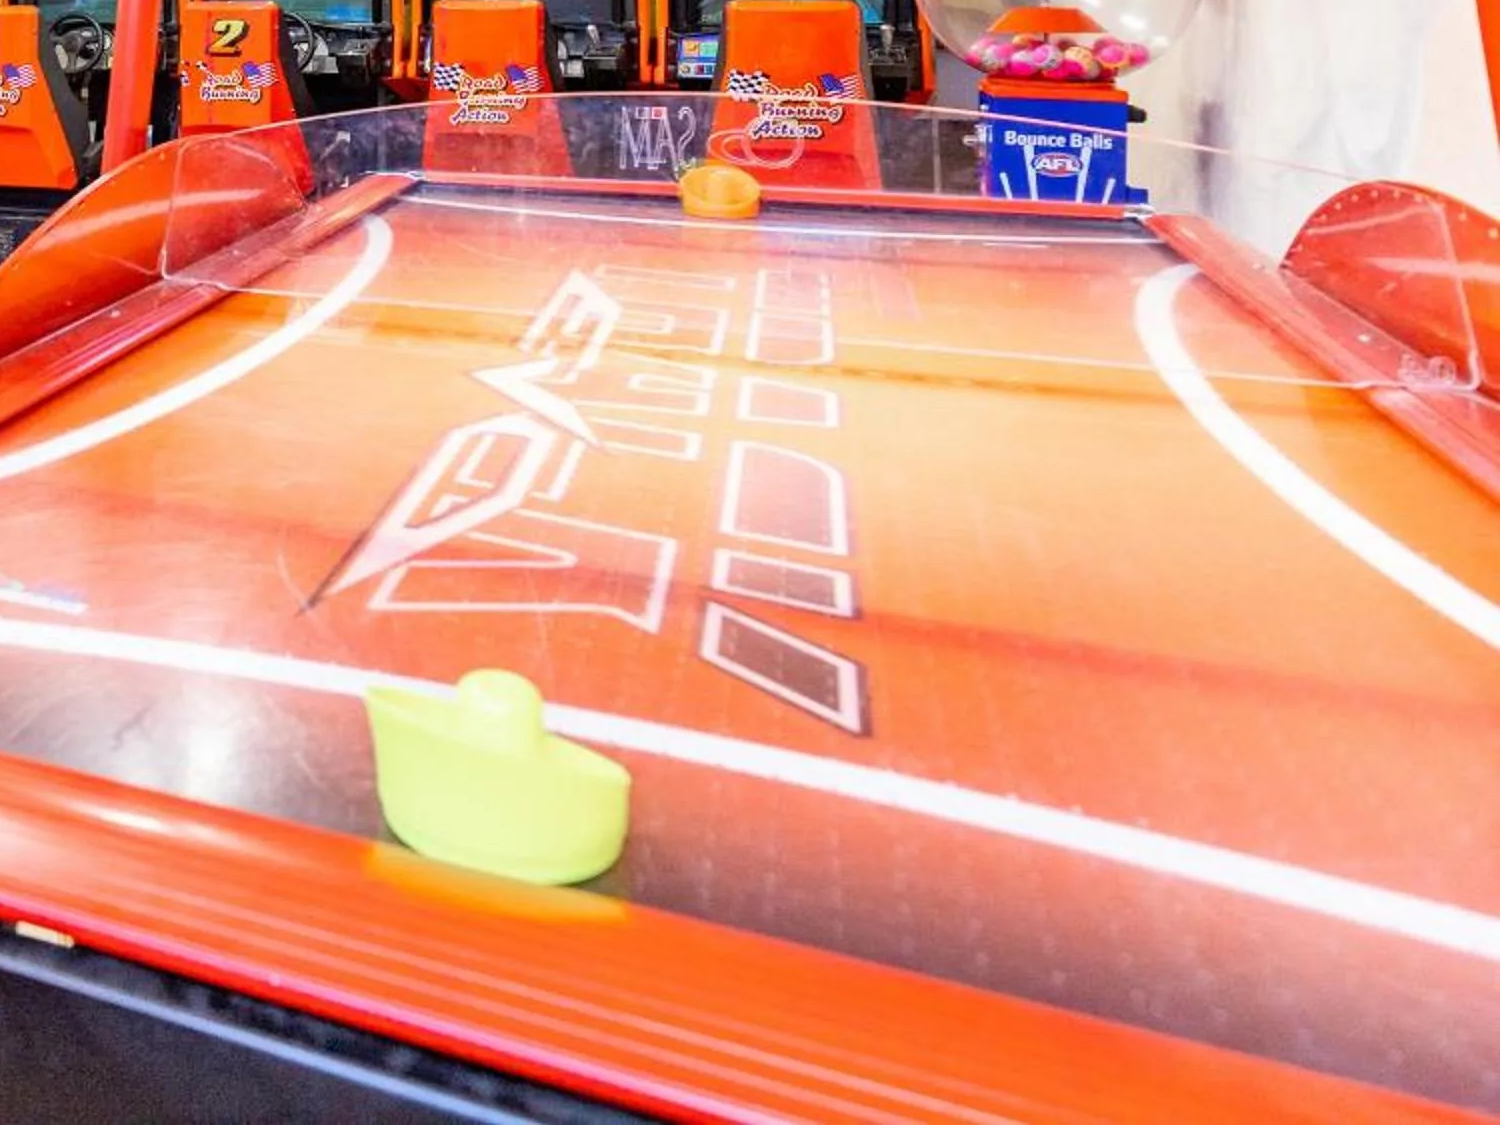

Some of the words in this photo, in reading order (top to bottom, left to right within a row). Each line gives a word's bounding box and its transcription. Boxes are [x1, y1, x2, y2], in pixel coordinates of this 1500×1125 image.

[211, 19, 246, 57] 2
[451, 105, 510, 125] Action
[760, 100, 843, 123] Running
[1004, 130, 1066, 147] Bounce
[1069, 132, 1113, 150] Balls
[1034, 157, 1081, 172] AFL
